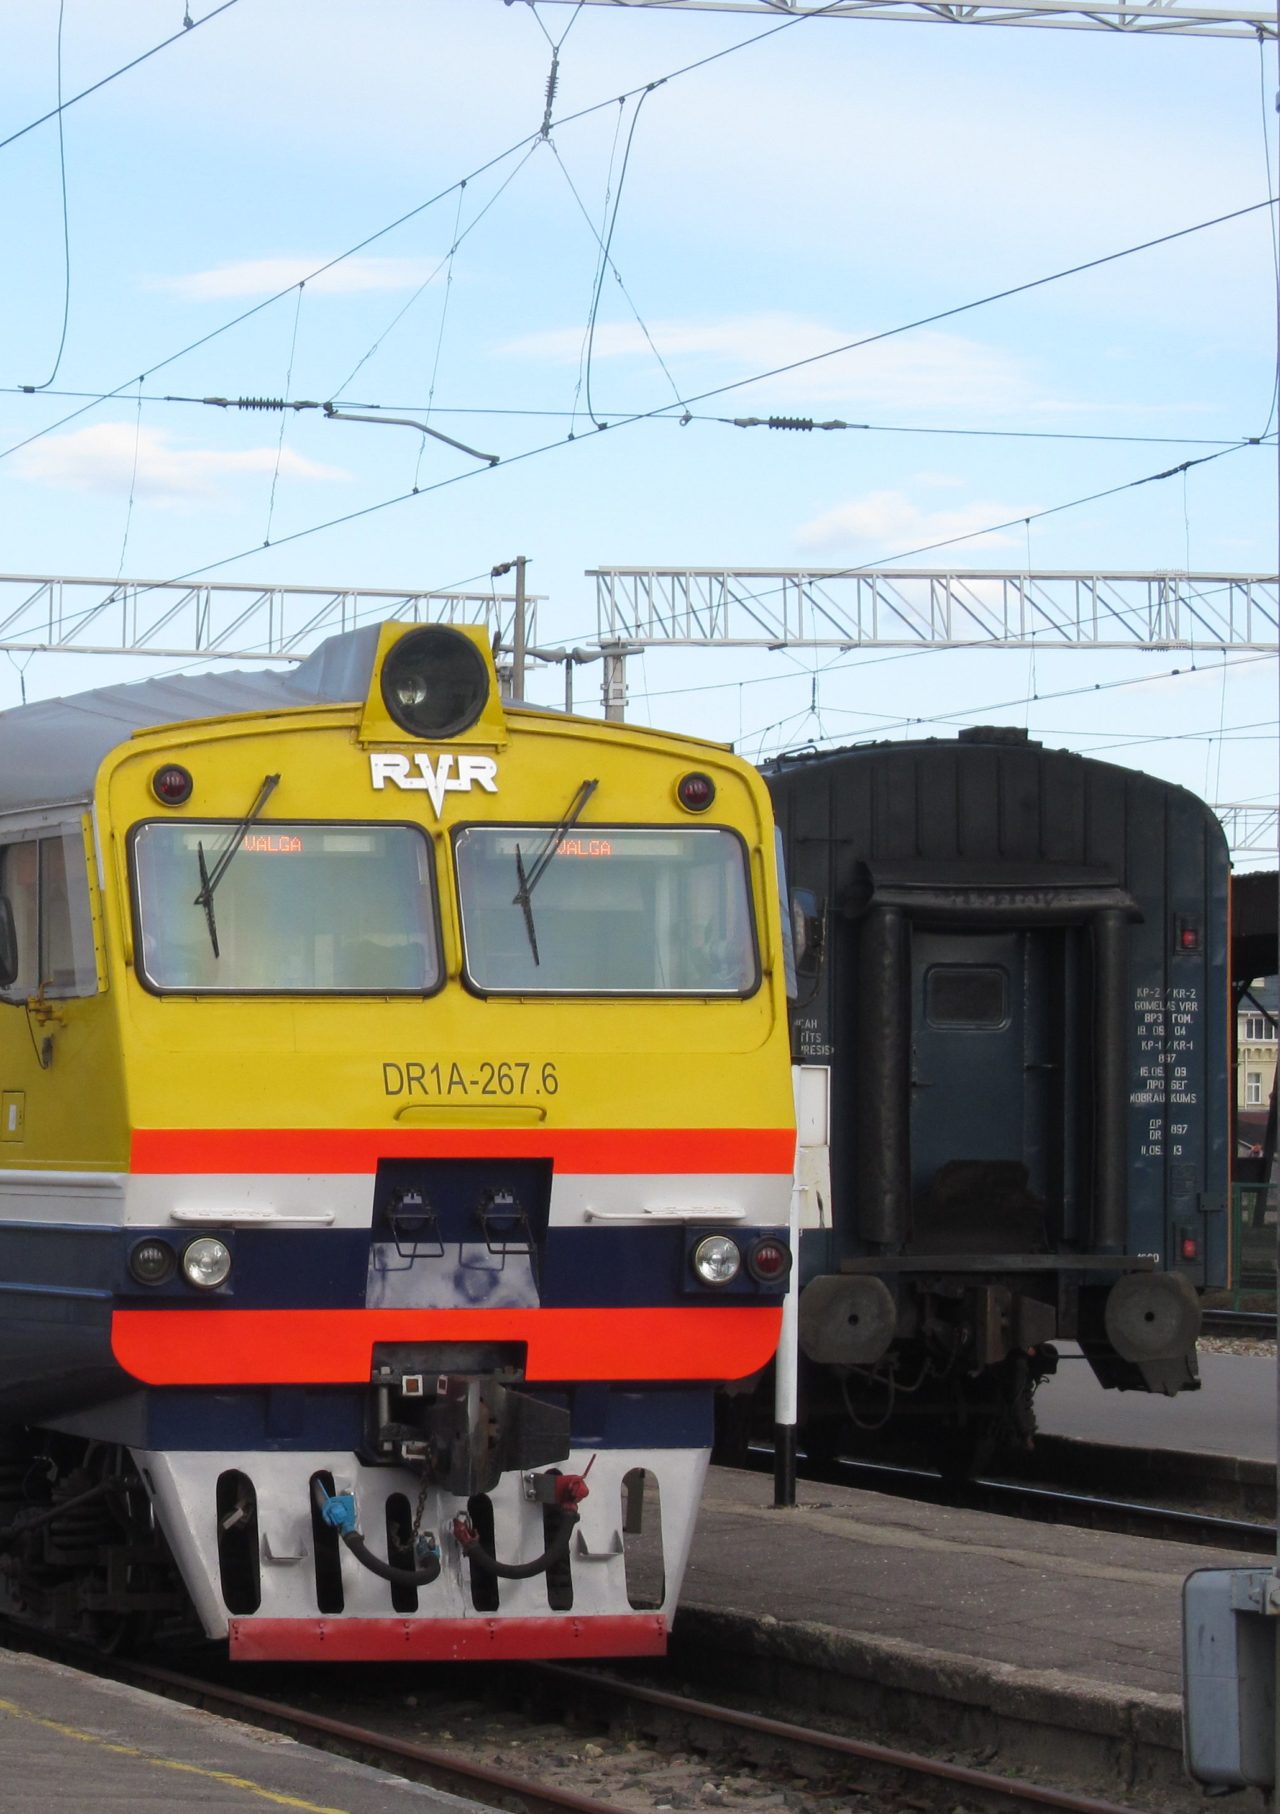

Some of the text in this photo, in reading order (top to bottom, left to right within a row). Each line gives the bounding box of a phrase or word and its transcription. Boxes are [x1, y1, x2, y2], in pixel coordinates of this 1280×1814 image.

[370, 753, 499, 820] RVR
[244, 835, 302, 853] VALGA
[555, 839, 611, 855] VALGA
[1173, 988, 1197, 999] KR-2
[1179, 1001, 1199, 1012] VRR
[382, 1062, 559, 1096] DR1A-267.6
